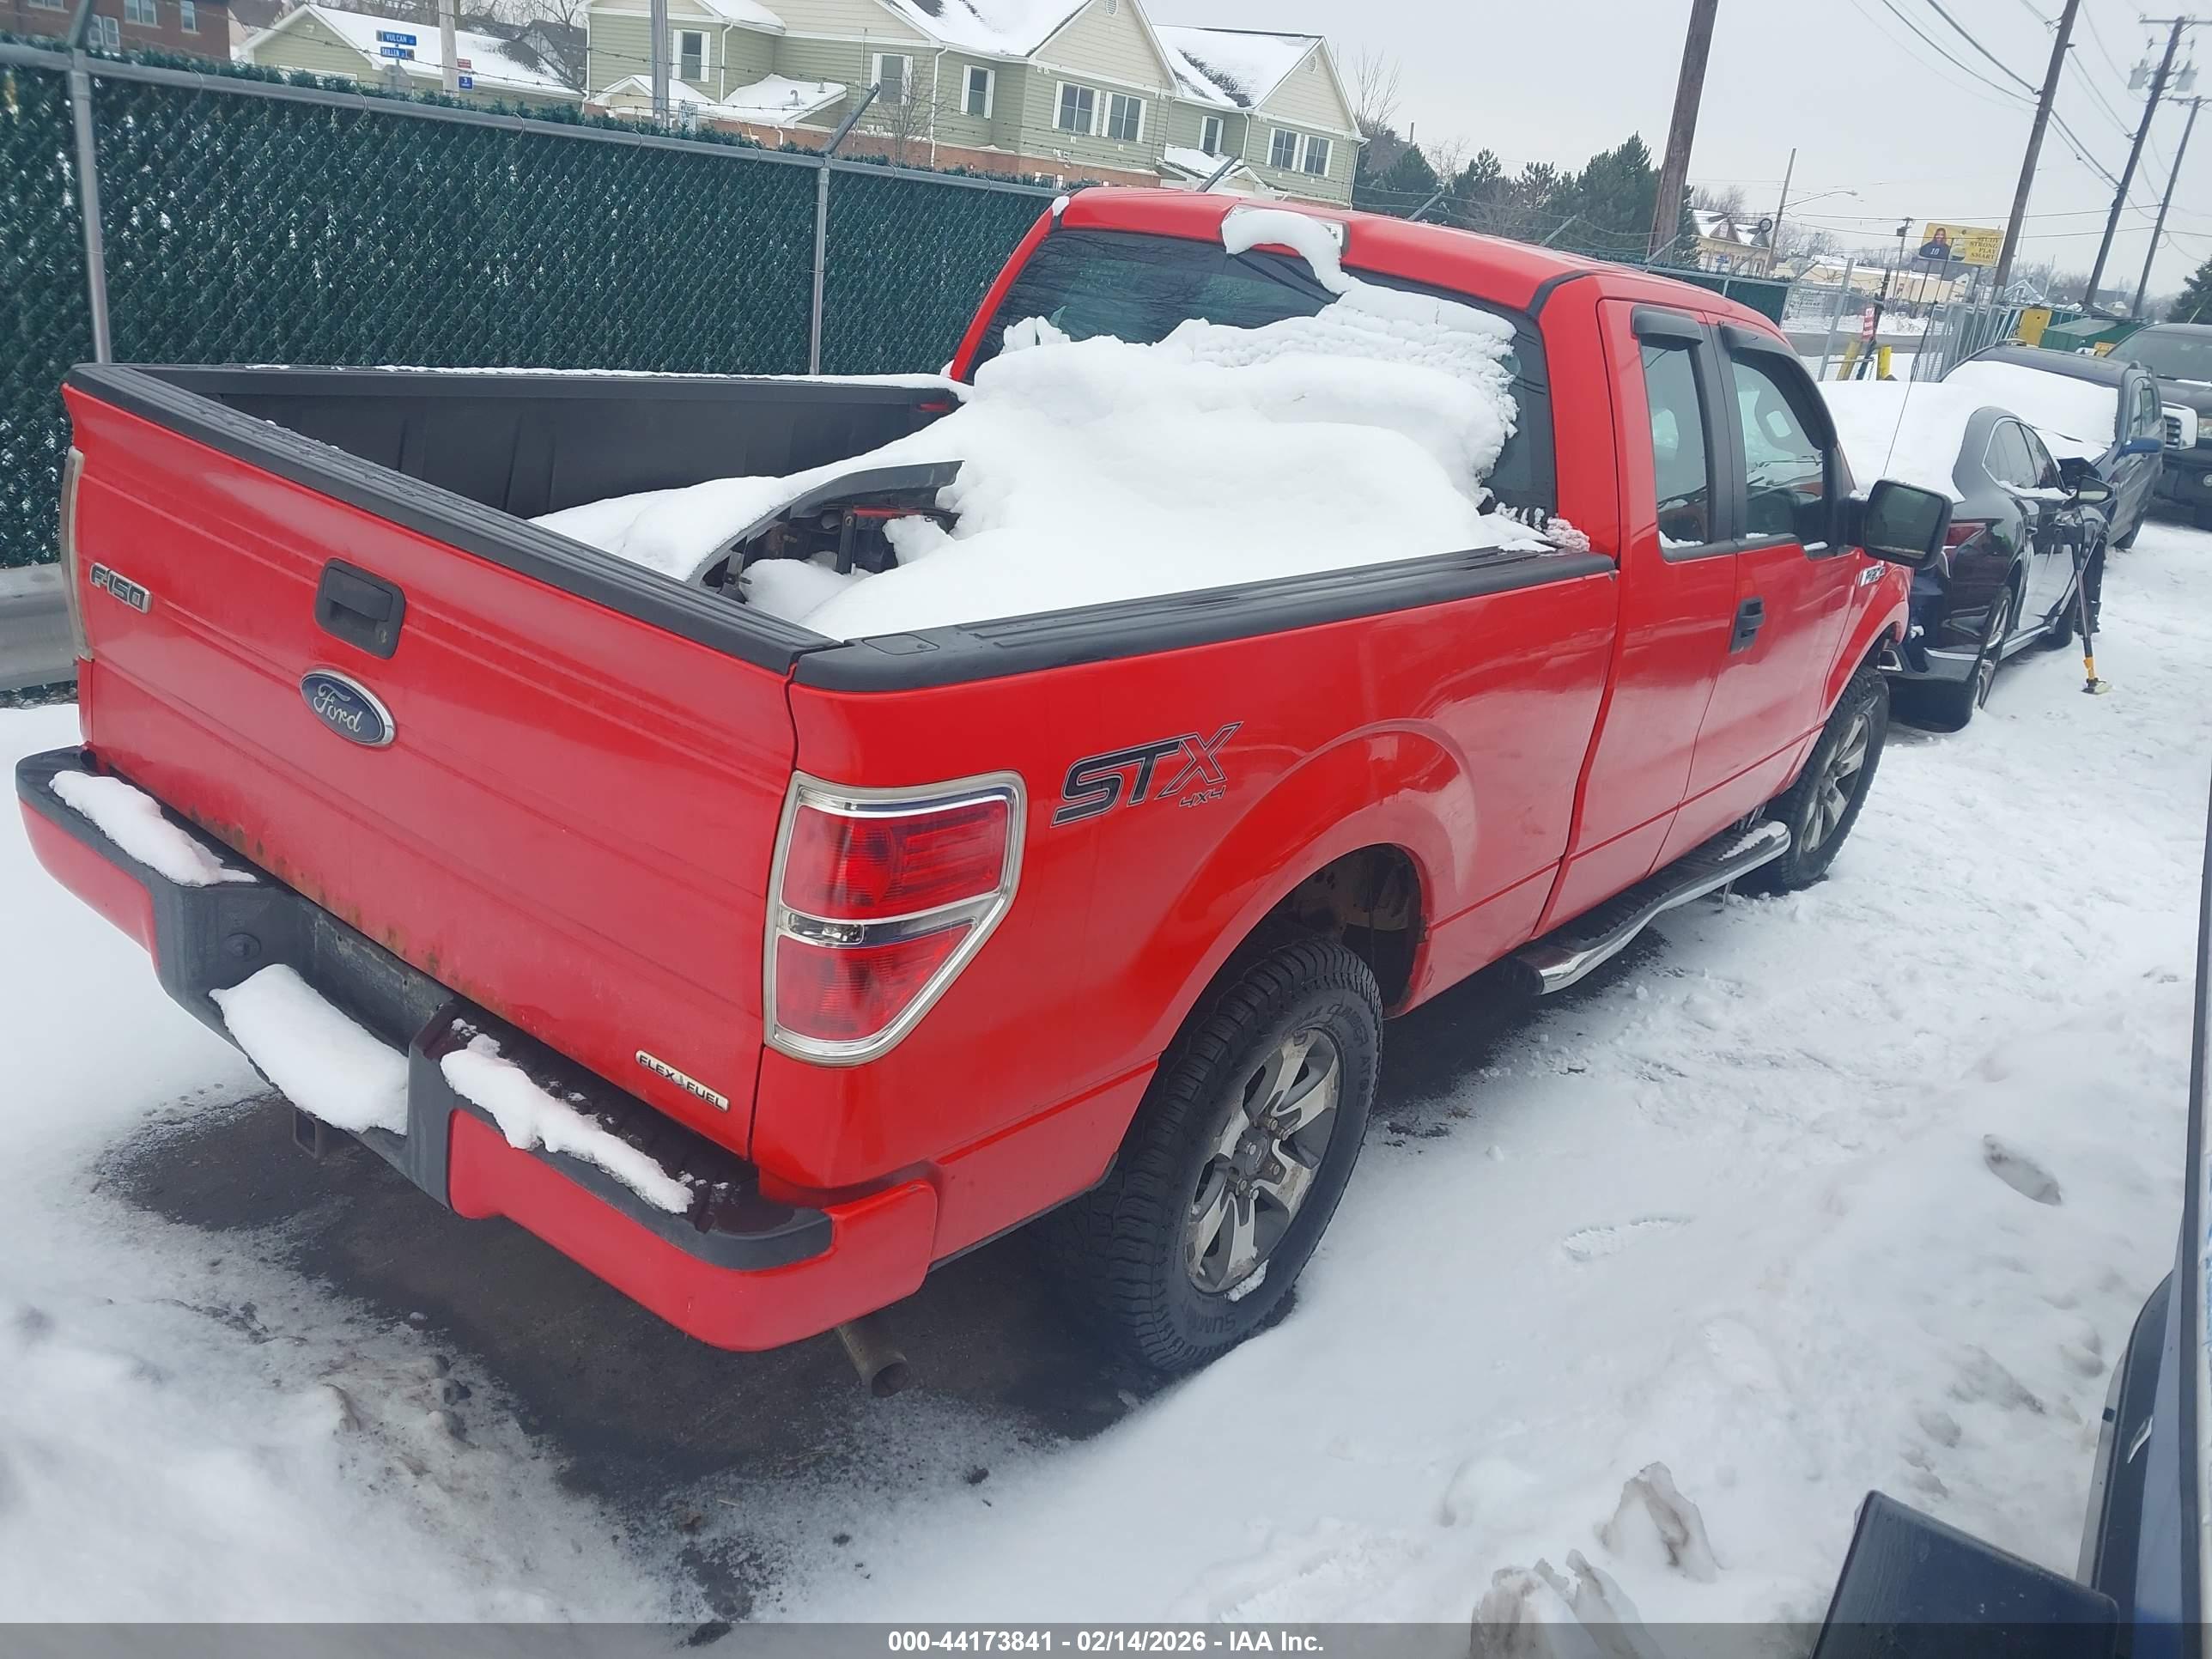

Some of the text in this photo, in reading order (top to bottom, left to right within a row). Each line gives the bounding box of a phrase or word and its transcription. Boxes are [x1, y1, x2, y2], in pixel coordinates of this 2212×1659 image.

[386, 33, 407, 43] VULCAN
[89, 562, 152, 614] F150
[313, 684, 362, 732] Ford
[1049, 721, 1244, 829] STX
[639, 1054, 724, 1111] FLEX FUEL
